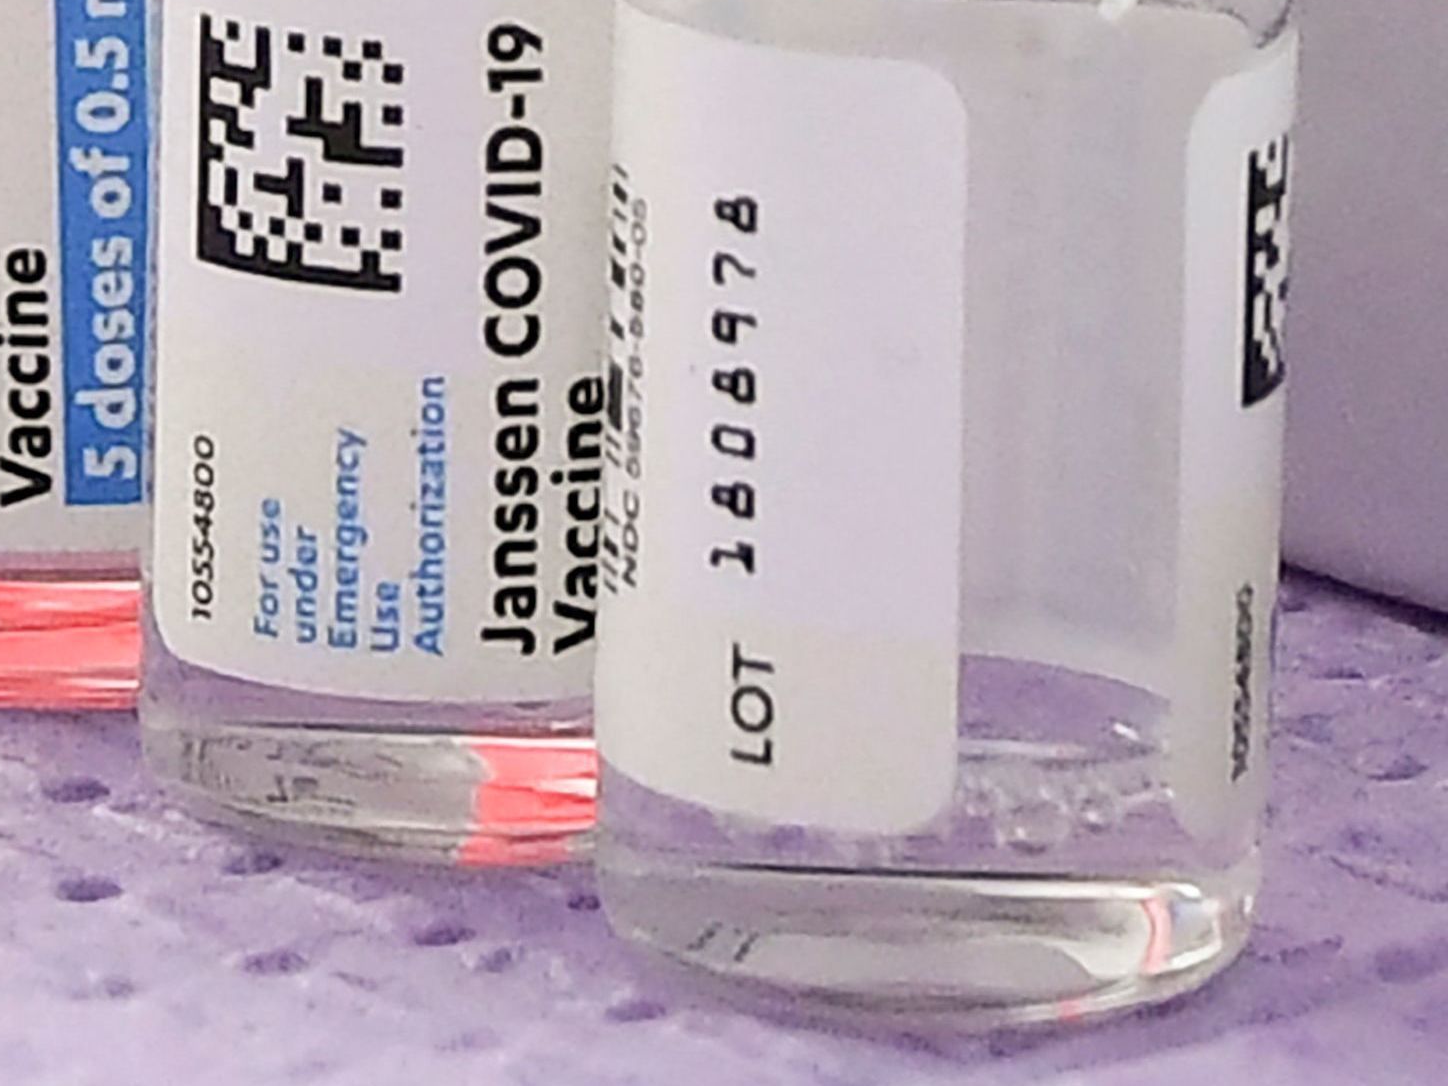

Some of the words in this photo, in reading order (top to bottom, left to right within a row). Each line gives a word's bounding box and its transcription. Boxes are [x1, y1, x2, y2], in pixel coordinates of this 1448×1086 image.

[75, 36, 132, 135] 0.5
[69, 147, 132, 220] of
[482, 23, 544, 358] COVID-19
[76, 235, 136, 430] doses
[709, 193, 760, 575] 1808978
[83, 445, 139, 481] 5
[409, 375, 446, 657] Authorization
[480, 378, 538, 657] Janssen
[550, 375, 606, 656] Vaccine
[191, 434, 215, 621] 10554800
[262, 498, 282, 565] use
[294, 524, 319, 644] under
[327, 426, 368, 650] Emergency
[620, 490, 640, 588] NDC
[255, 570, 281, 639] For
[371, 581, 400, 654] Use
[730, 642, 778, 768] LOT
